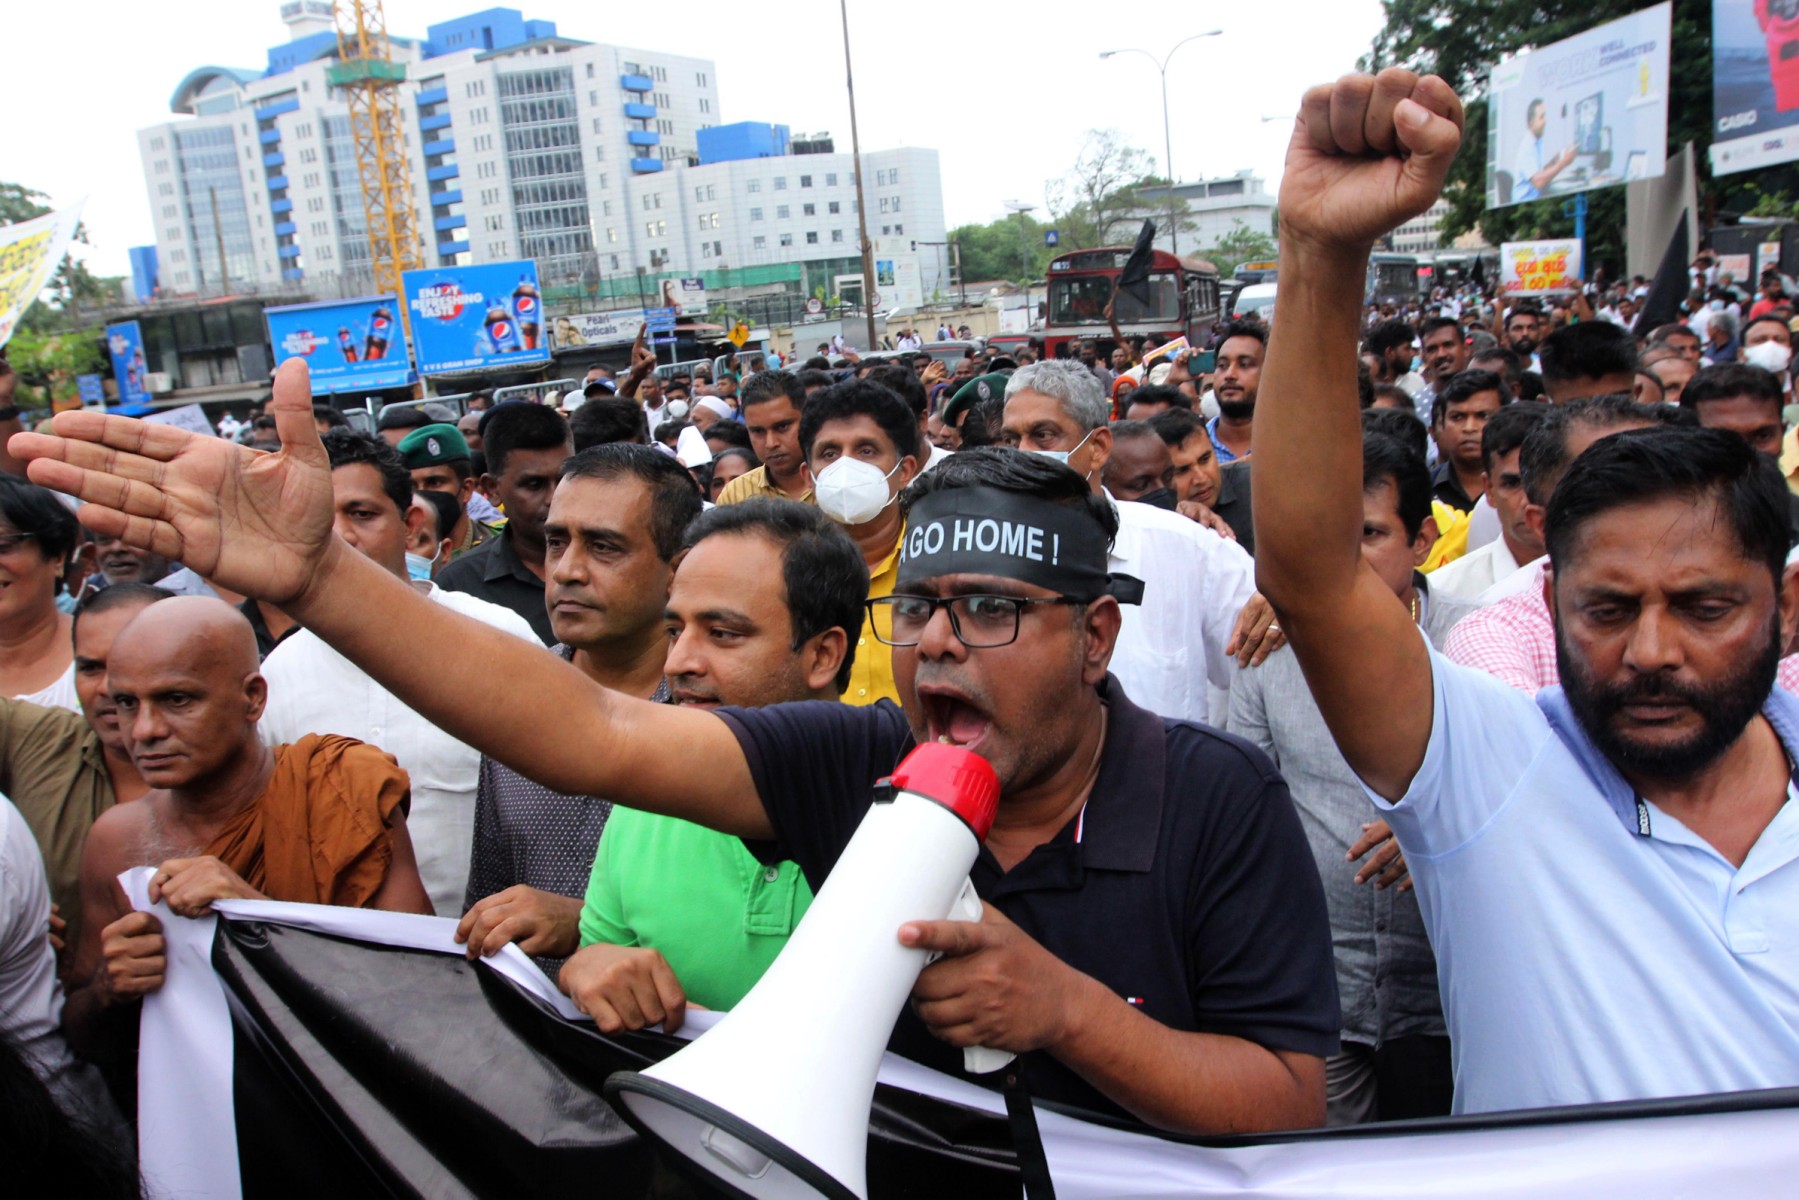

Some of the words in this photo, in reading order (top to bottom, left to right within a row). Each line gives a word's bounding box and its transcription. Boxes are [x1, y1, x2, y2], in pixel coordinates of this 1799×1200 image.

[1600, 39, 1624, 54] WELL
[1600, 40, 1657, 66] CONNECTED
[1718, 109, 1757, 133] CASIO
[418, 285, 459, 299] ENJOY
[411, 292, 484, 310] REFRESHING
[421, 304, 454, 318] TASTE
[586, 314, 610, 325] Pearl
[582, 324, 617, 339] Opticals
[910, 522, 944, 559] GO
[952, 519, 1044, 561] HOME
[1052, 534, 1059, 566] !
